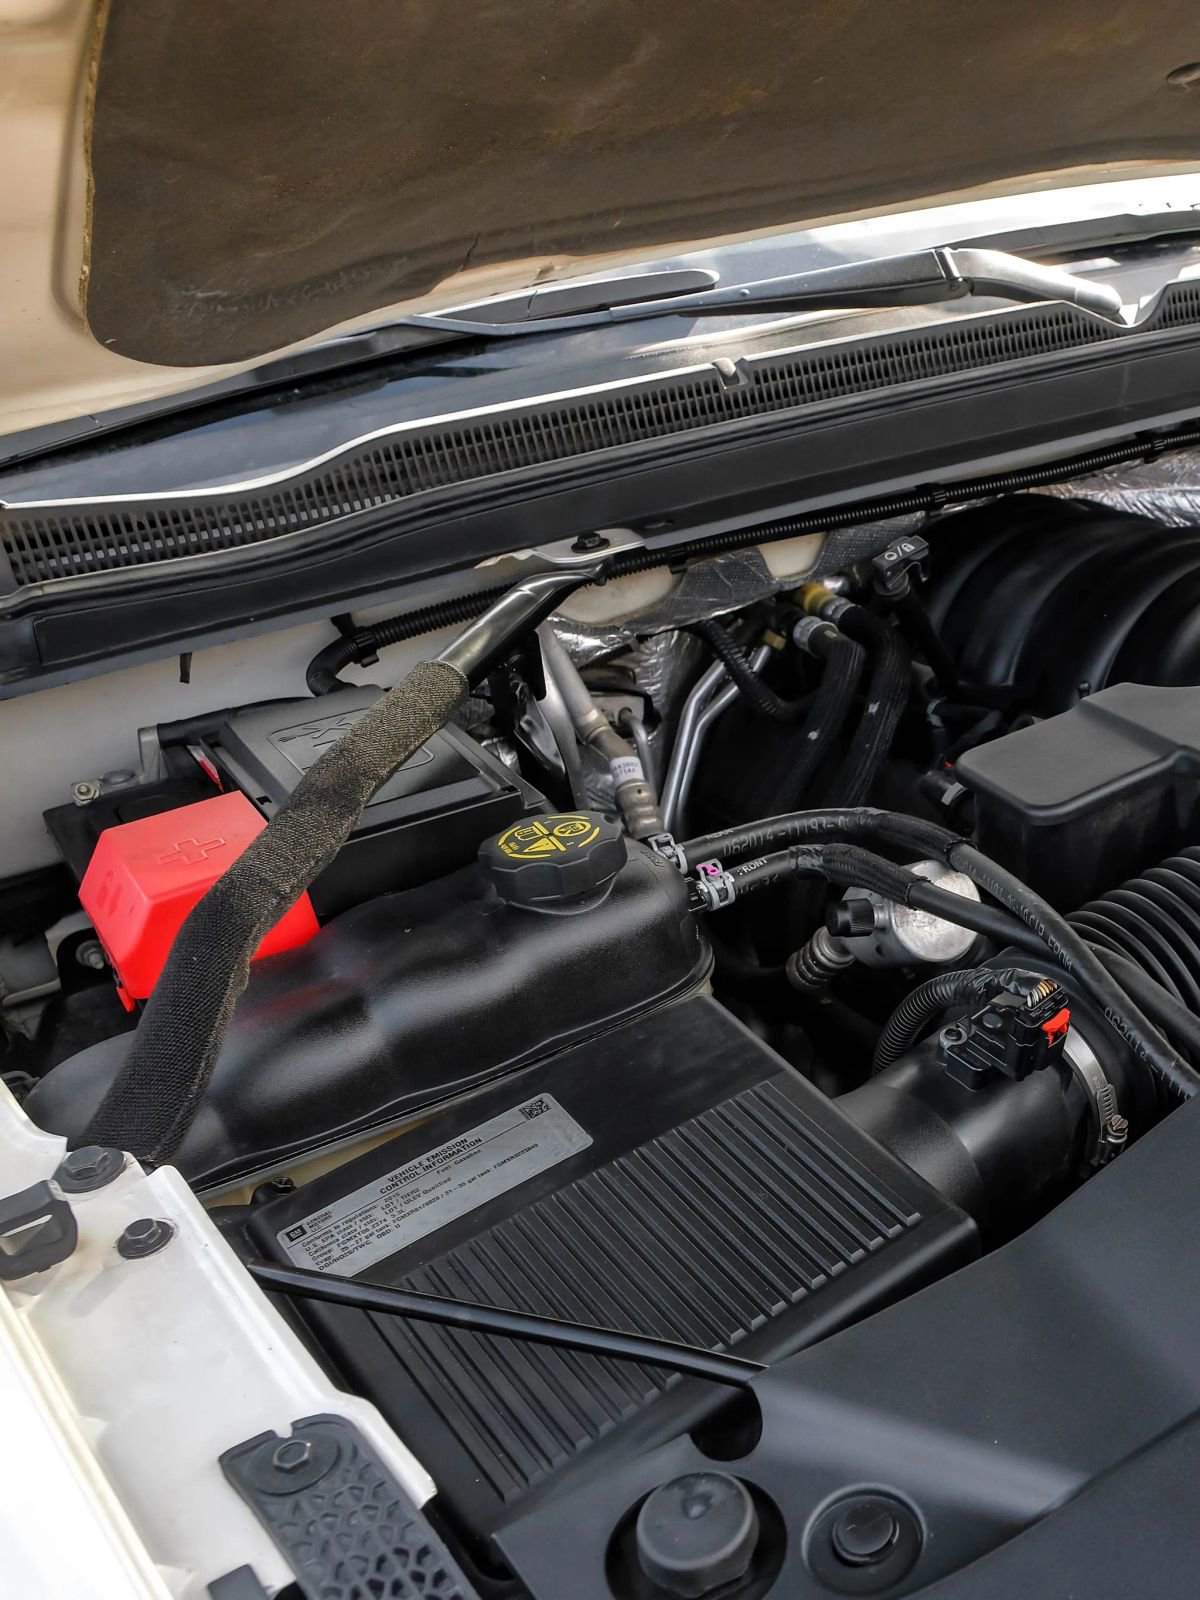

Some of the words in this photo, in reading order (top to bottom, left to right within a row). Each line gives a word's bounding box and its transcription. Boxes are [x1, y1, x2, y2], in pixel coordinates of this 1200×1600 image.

[380, 1170, 421, 1194] CONTROL
[423, 1138, 482, 1171] INFORMATION
[388, 1161, 425, 1182] VEHICLE
[426, 1139, 468, 1162] EMISSION
[306, 1210, 331, 1225] GENERAL
[309, 1215, 332, 1228] MOTORS
[303, 1229, 332, 1247] Conforms
[309, 1238, 339, 1256] California
[322, 1234, 335, 1242] EPA
